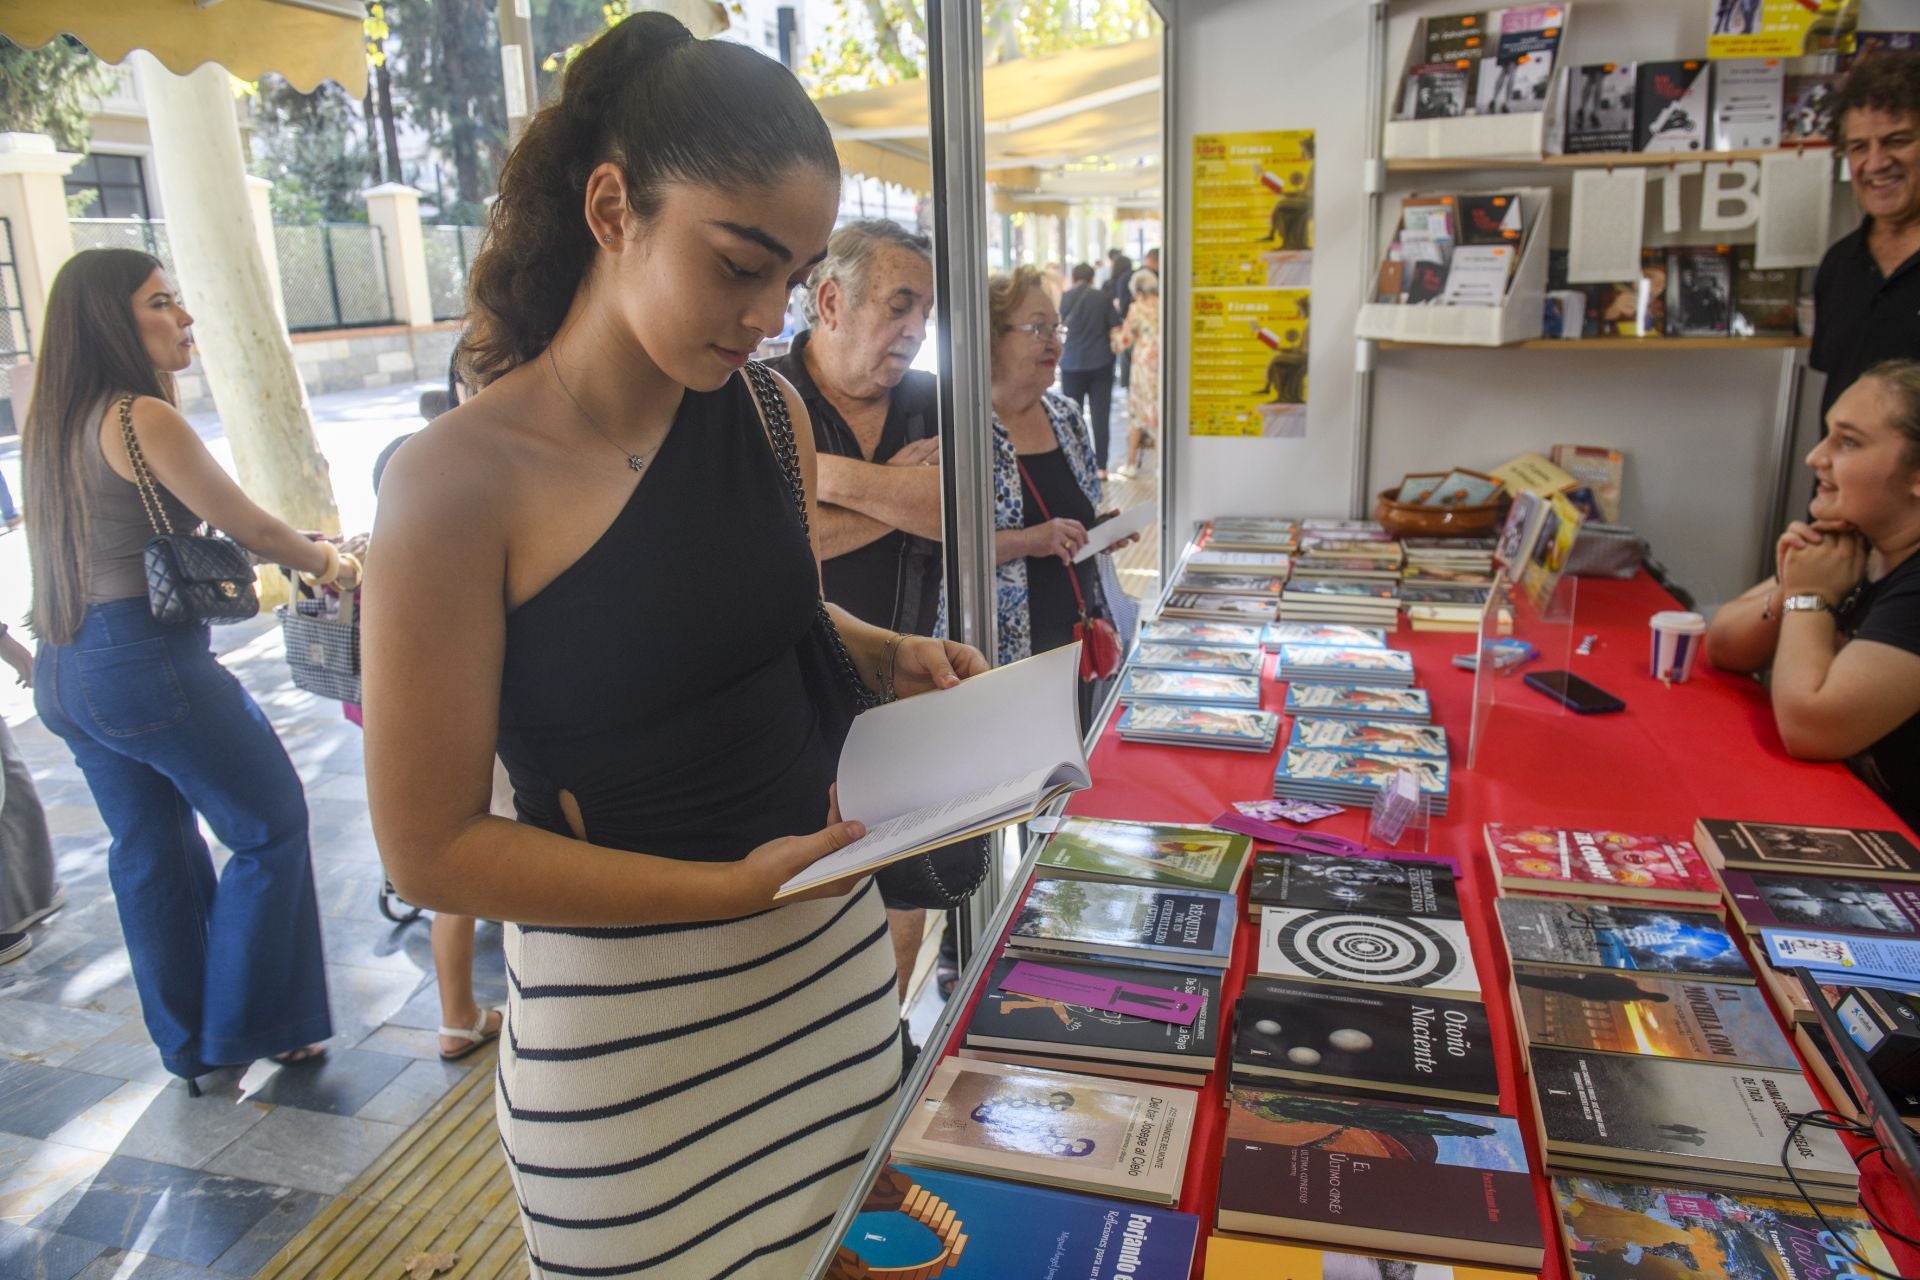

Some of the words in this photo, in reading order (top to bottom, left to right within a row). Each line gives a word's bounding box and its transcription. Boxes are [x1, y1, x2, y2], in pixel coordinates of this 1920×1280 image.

[1154, 899, 1175, 944] GUERRILLERO
[1182, 903, 1207, 944] RÉQUIEM
[1715, 988, 1742, 1001] LA
[1443, 1009, 1472, 1058] Otoño
[1681, 984, 1738, 1057] MOCHILA.COM
[1175, 1034, 1190, 1050] Raya
[1411, 1004, 1438, 1074] Naciente
[1145, 1109, 1160, 1121] bar
[1148, 1097, 1163, 1110] Del
[1136, 1120, 1156, 1147] Josepe
[1134, 1147, 1148, 1157] al
[1128, 1156, 1146, 1177] Cielo
[1329, 1153, 1350, 1187] ÚLTIMO
[1056, 1231, 1070, 1251] Miguel
[1099, 1210, 1120, 1248] Reflexiones
[1769, 1229, 1786, 1256] Tomás
[1094, 1247, 1106, 1265] para
[1117, 1213, 1153, 1273] Forjando
[1090, 1265, 1101, 1277] un
